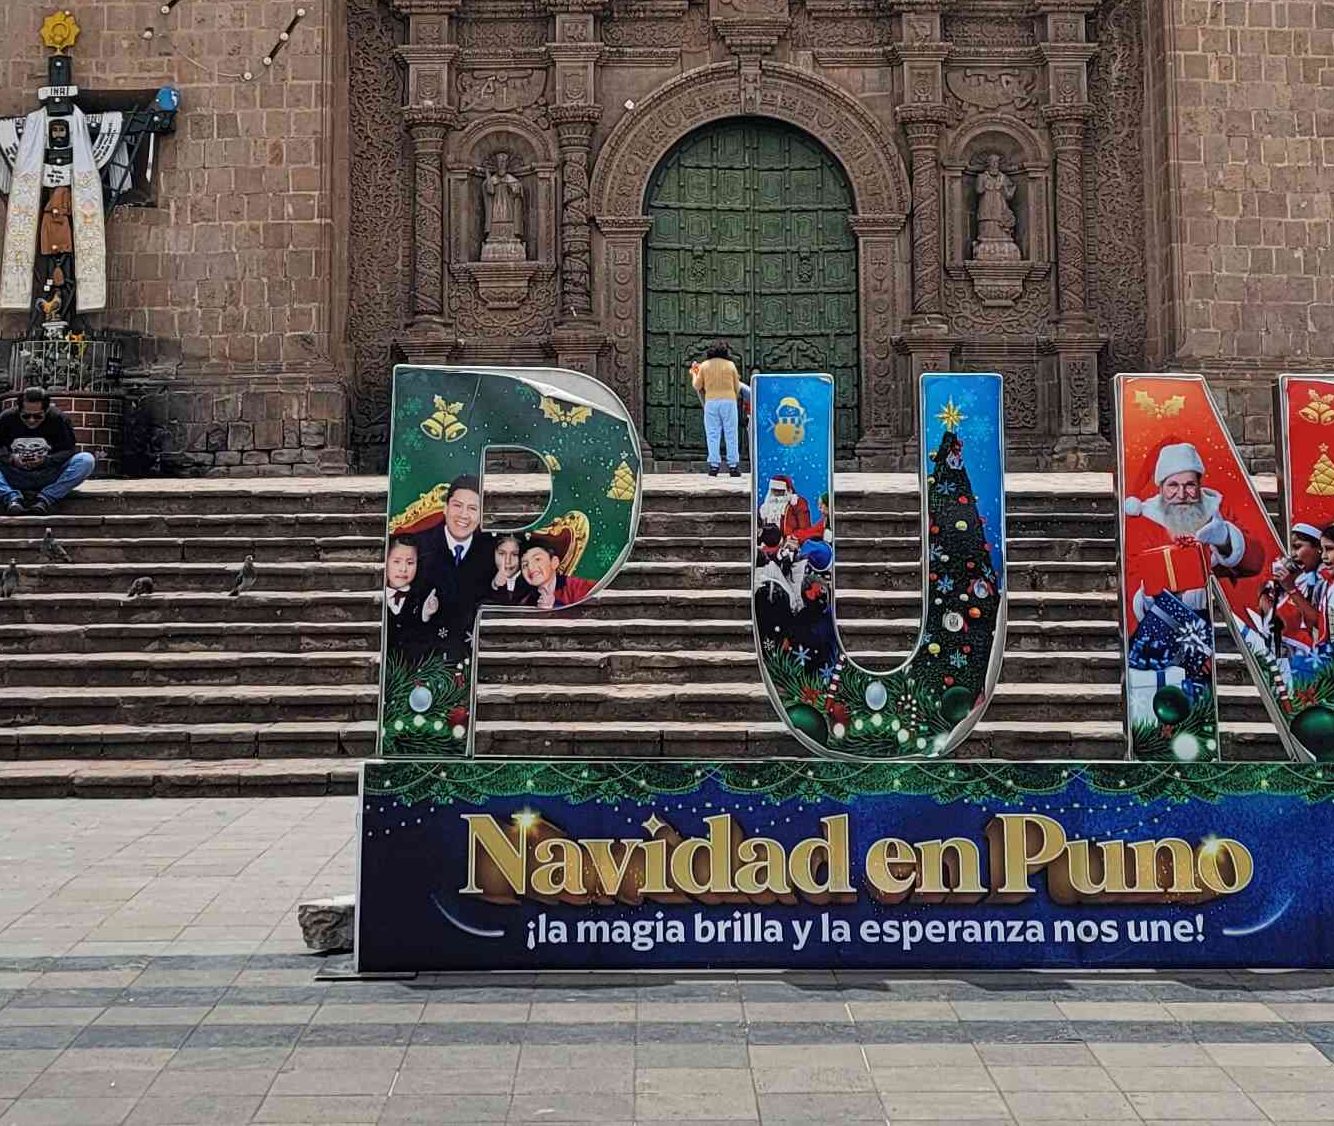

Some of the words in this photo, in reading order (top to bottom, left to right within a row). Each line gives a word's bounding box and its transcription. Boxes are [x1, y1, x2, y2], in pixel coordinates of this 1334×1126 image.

[458, 813, 858, 897] Navidad
[865, 837, 989, 895] en
[994, 812, 1255, 896] Puno
[526, 913, 568, 951] ¡la
[576, 910, 686, 952] magia
[694, 910, 784, 944] brilla
[791, 919, 813, 951] y
[820, 912, 852, 944] la
[859, 918, 1046, 951] esperanza
[1053, 919, 1118, 944] nos
[1127, 913, 1206, 944] une!
